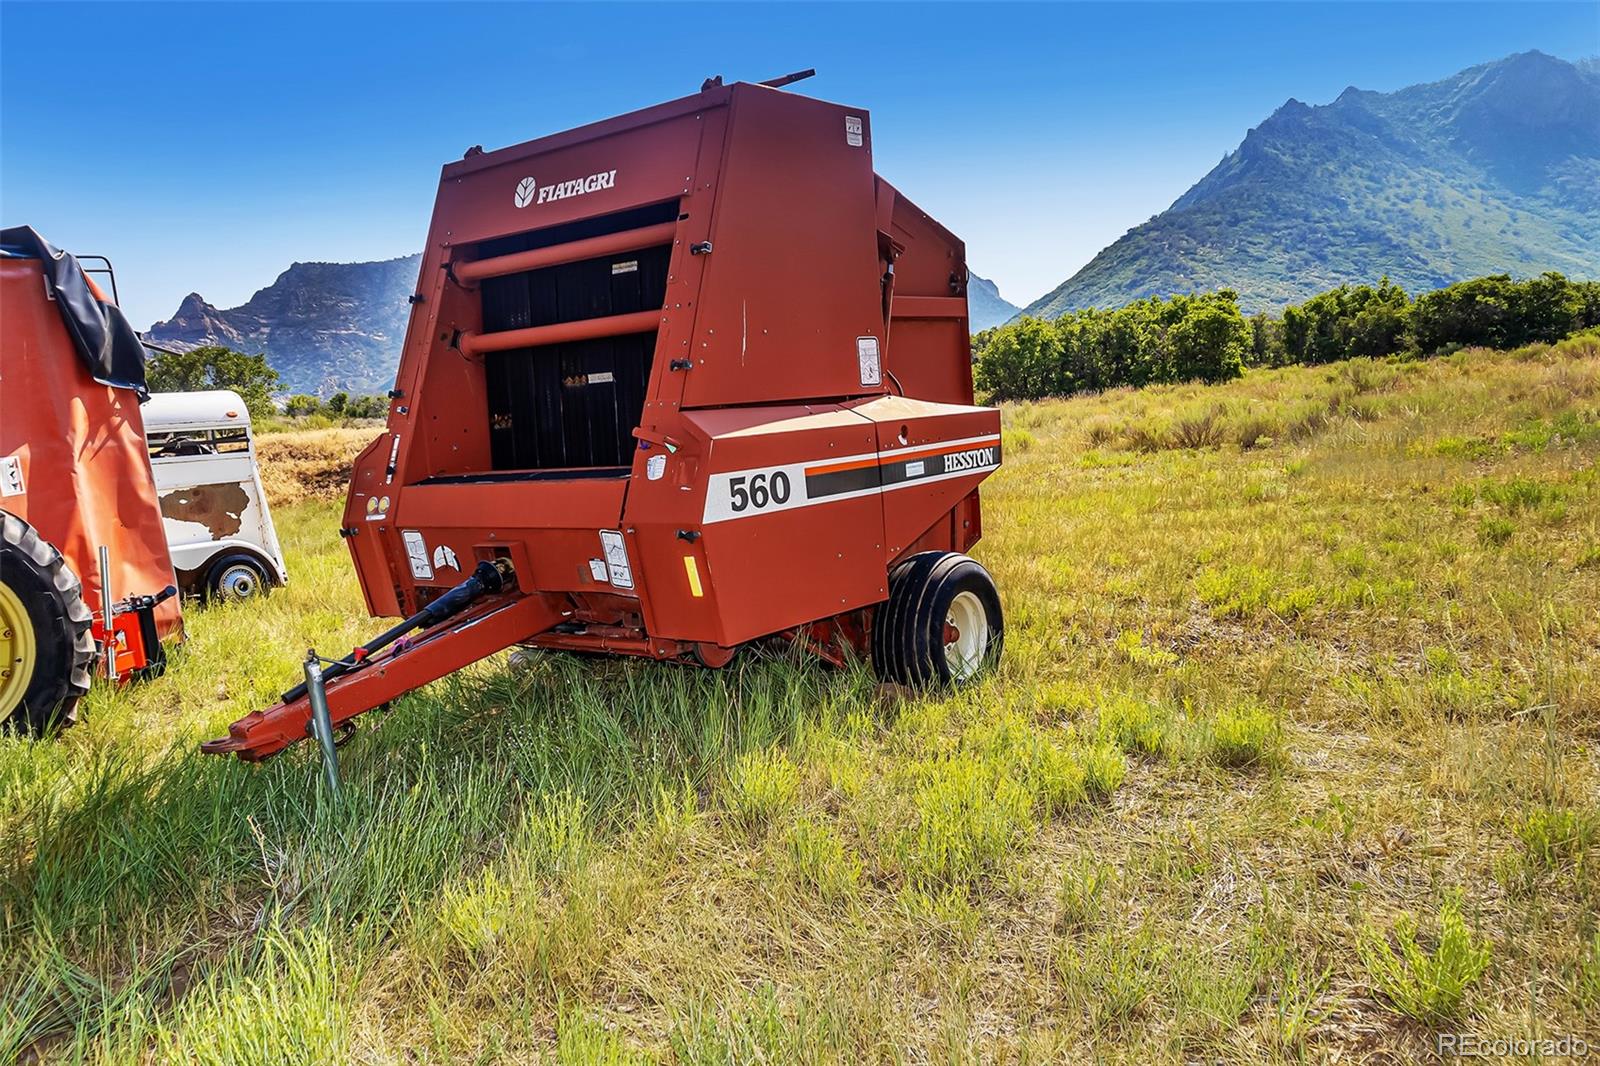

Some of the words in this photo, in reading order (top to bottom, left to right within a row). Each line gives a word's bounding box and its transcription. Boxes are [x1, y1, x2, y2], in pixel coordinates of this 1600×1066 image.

[537, 170, 616, 204] FIATAGRI
[943, 448, 994, 473] HESSTON
[729, 471, 791, 512] 560
